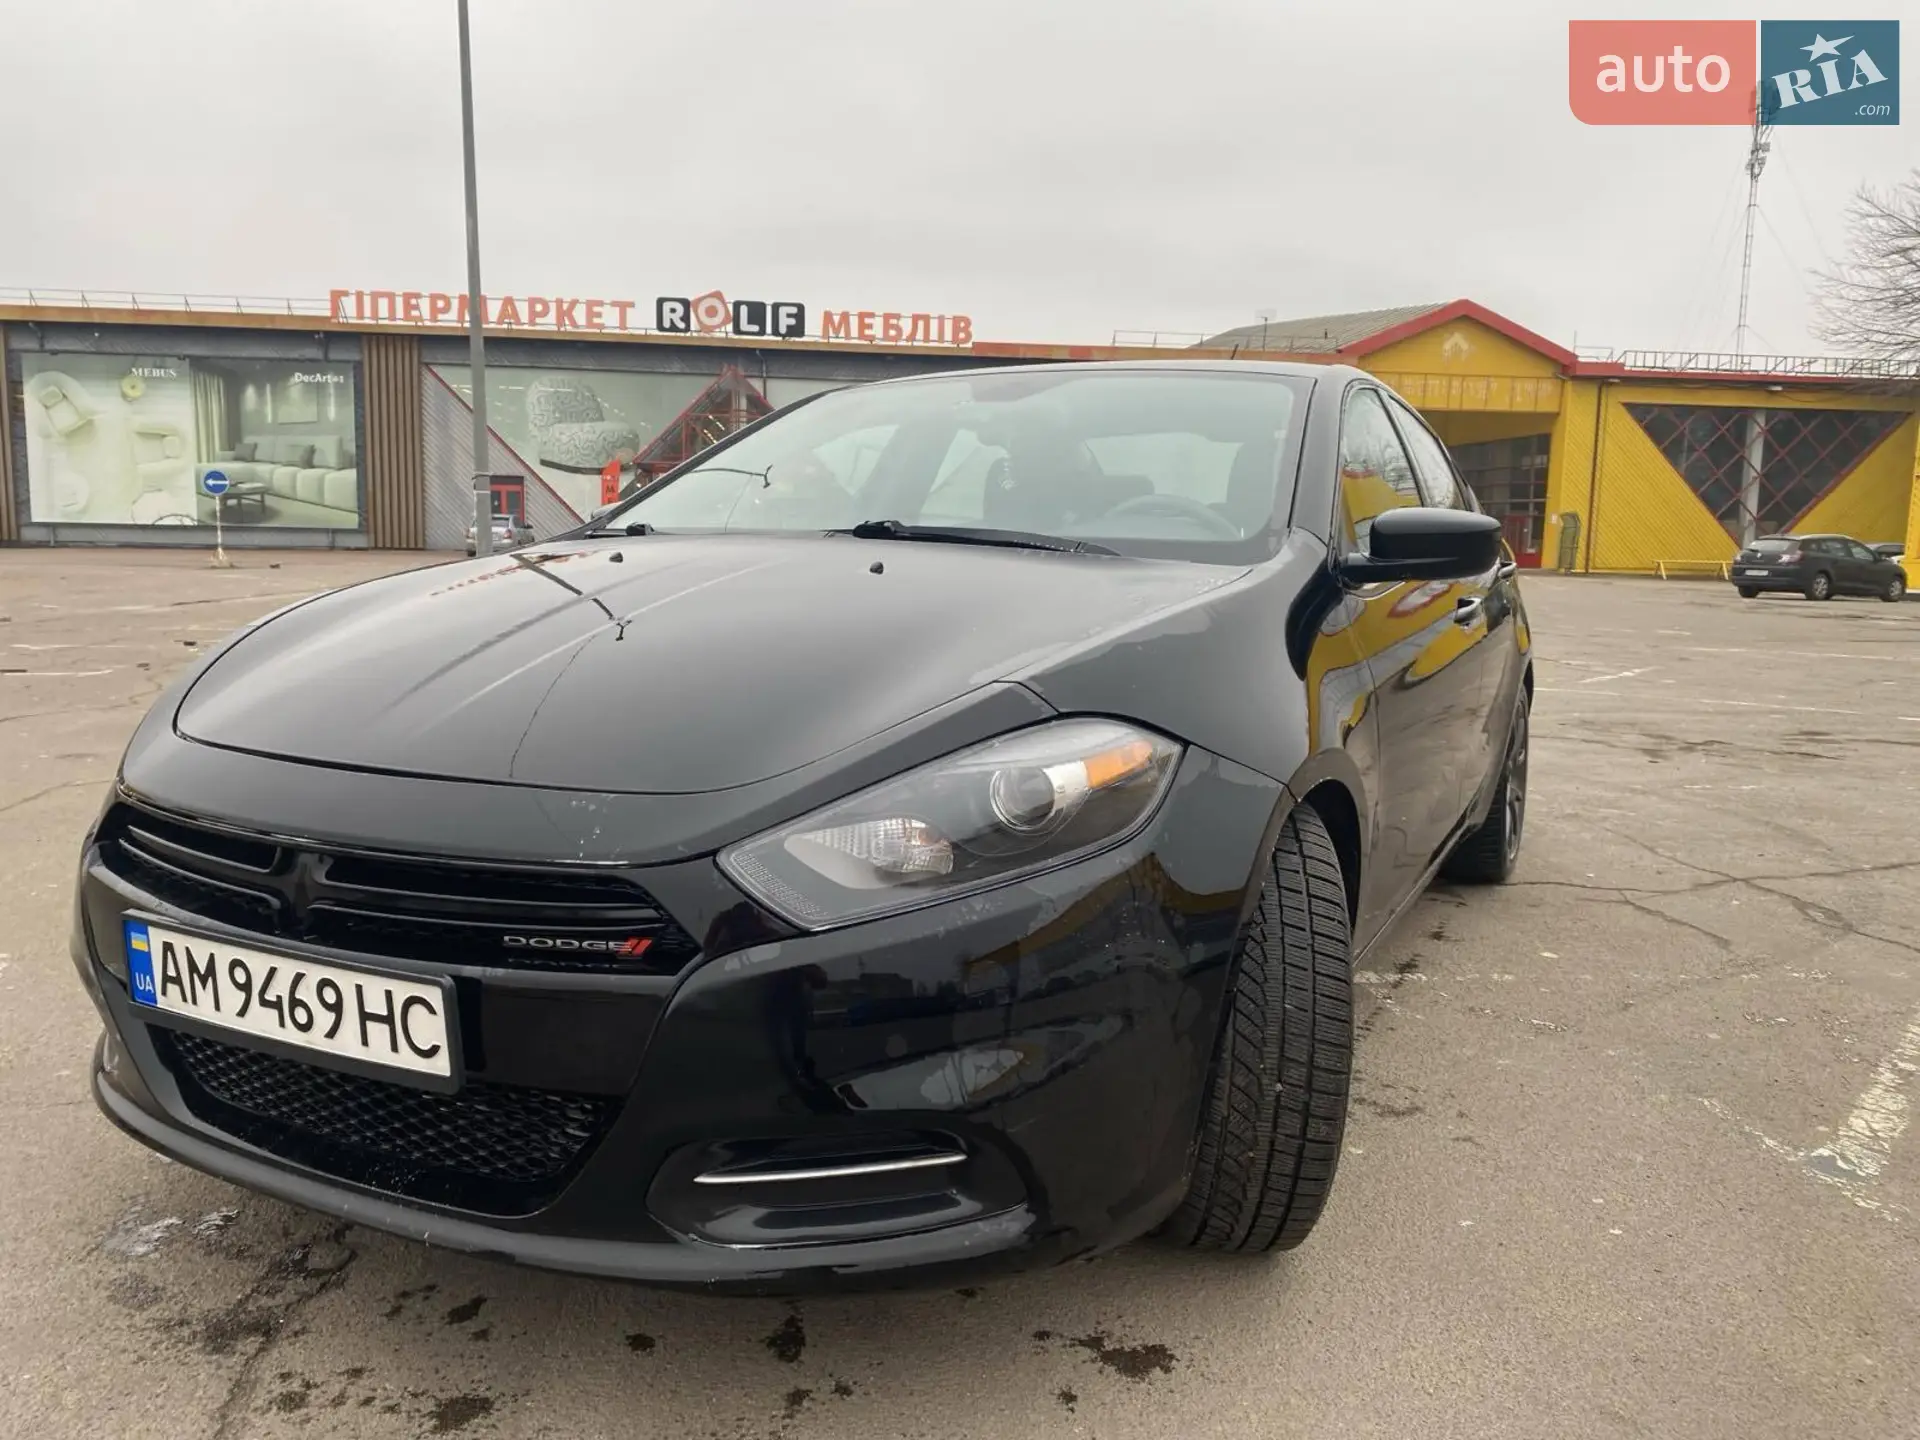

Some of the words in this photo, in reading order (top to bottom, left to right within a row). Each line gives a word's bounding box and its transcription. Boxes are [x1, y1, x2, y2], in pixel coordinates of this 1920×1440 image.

[330, 289, 635, 330] ГІПЕРМАРКЕТ
[660, 295, 799, 336] ROLF
[821, 310, 973, 344] МЕБЛІВ
[502, 934, 633, 952] DODGE
[135, 971, 155, 994] UA
